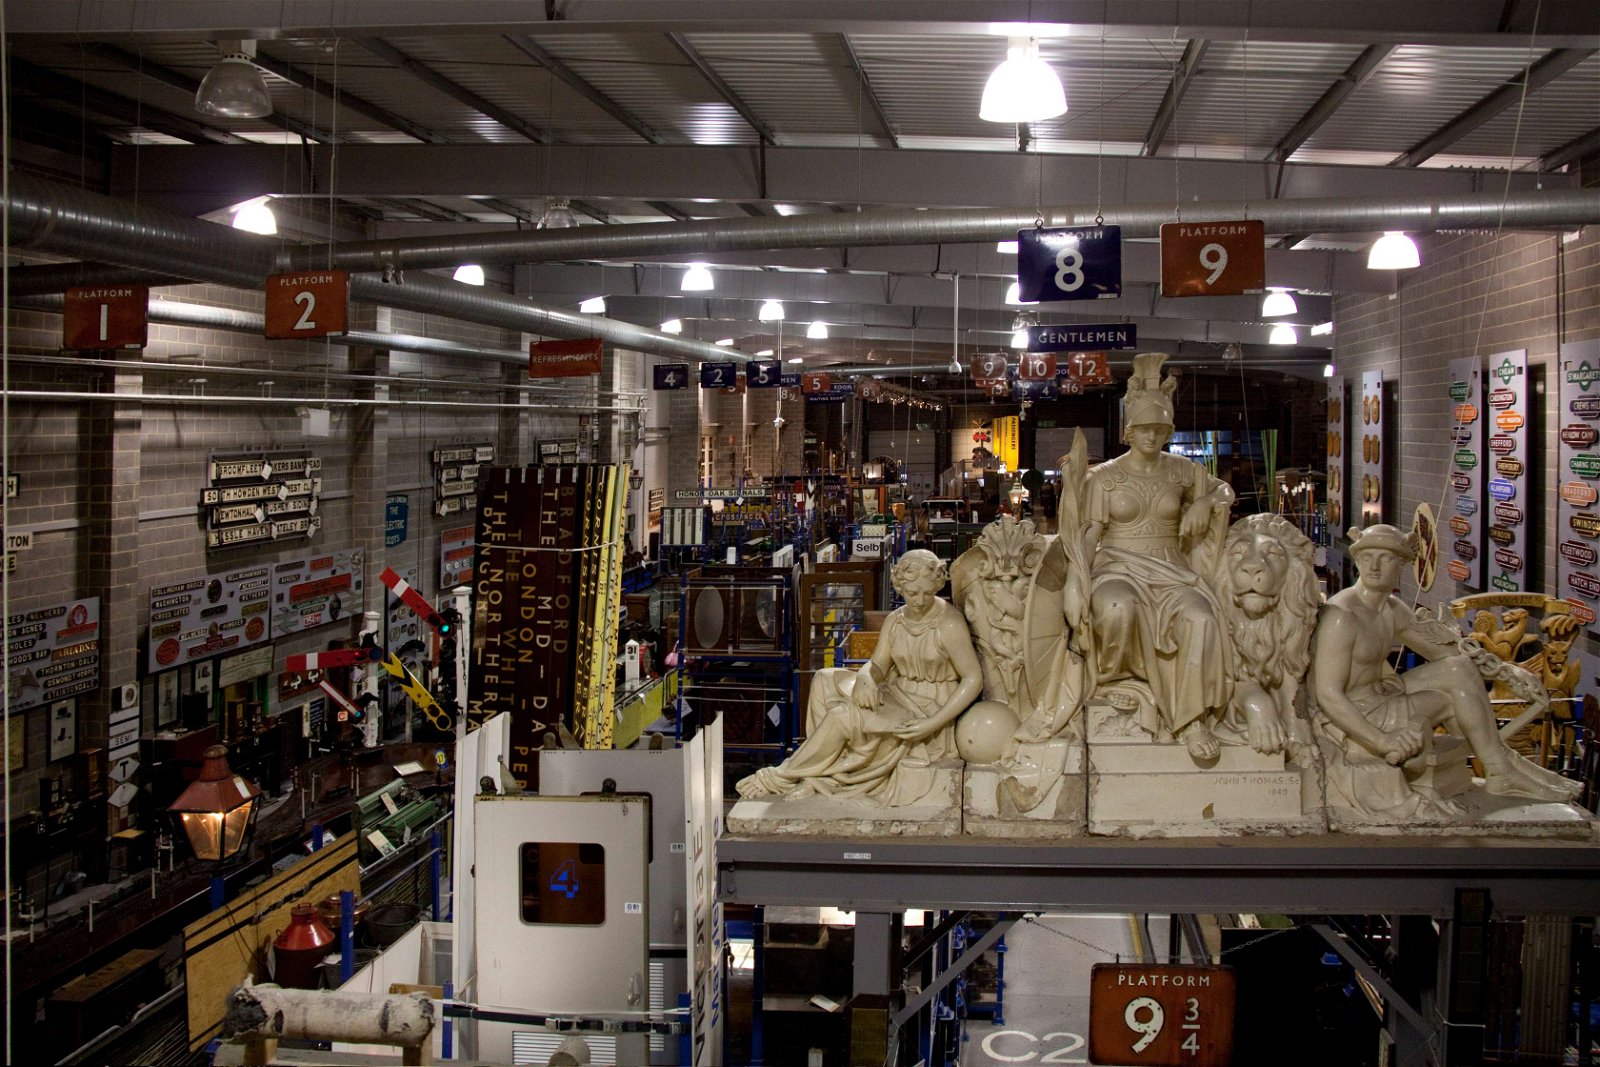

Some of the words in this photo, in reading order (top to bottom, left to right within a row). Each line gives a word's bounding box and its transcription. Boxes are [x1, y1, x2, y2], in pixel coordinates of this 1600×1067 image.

[1180, 226, 1247, 236] PLATFORM
[1054, 249, 1085, 292] 8
[1199, 243, 1228, 285] 9
[280, 275, 333, 286] PLATFORM
[79, 289, 132, 298] PLATFORM
[293, 291, 316, 330] 2
[100, 304, 107, 340] 1
[1039, 331, 1127, 344] GENTLEMEN
[532, 352, 599, 364] REFRESHMENTS
[713, 368, 723, 383] 2
[759, 366, 769, 384] 5
[984, 362, 994, 377] 9
[1028, 360, 1047, 377] 10
[1077, 360, 1096, 376] 12
[664, 371, 676, 387] 4
[812, 378, 821, 390] 5
[782, 389, 788, 399] 8
[234, 487, 260, 500] HOWDEN
[262, 485, 281, 496] WEST
[678, 490, 704, 498] HONOR
[708, 489, 725, 497] OAK
[728, 488, 764, 497] SIGNALS
[491, 490, 508, 542] THE
[541, 488, 558, 546] THE
[247, 526, 268, 536] HAVEN
[856, 543, 881, 552] Selb
[1562, 545, 1592, 560] FLEETWOOD
[506, 529, 522, 582] THE
[553, 486, 575, 653] BRADFORD
[1571, 576, 1588, 589] HATCH
[518, 549, 539, 663] LONDON
[35, 650, 48, 659] BAY
[627, 646, 637, 655] 31
[580, 627, 592, 740] RIVIERA
[120, 761, 129, 778] T
[550, 858, 579, 899] 4
[1118, 974, 1210, 987] PLATFORM
[1124, 996, 1165, 1054] 9
[981, 1030, 1087, 1064] C2
